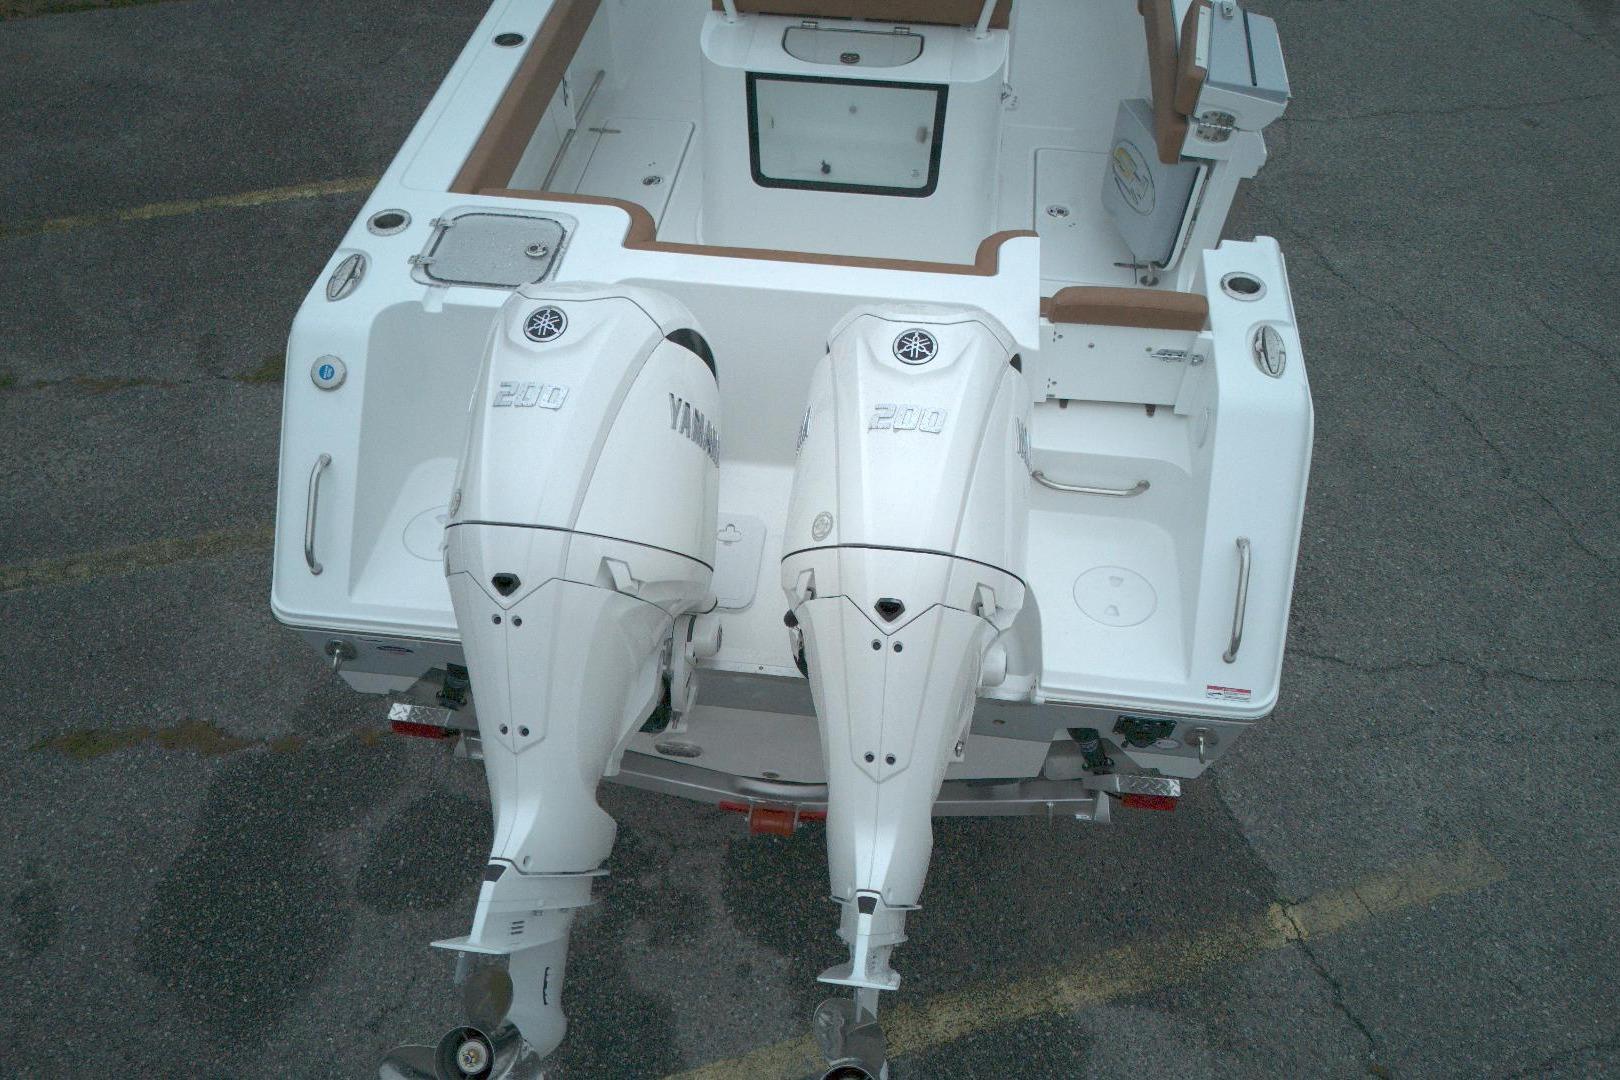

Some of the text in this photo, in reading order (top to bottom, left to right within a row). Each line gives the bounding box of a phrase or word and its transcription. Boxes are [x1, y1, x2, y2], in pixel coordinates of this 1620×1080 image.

[493, 381, 569, 410] 200
[669, 392, 720, 468] YAMA
[868, 403, 947, 434] 200
